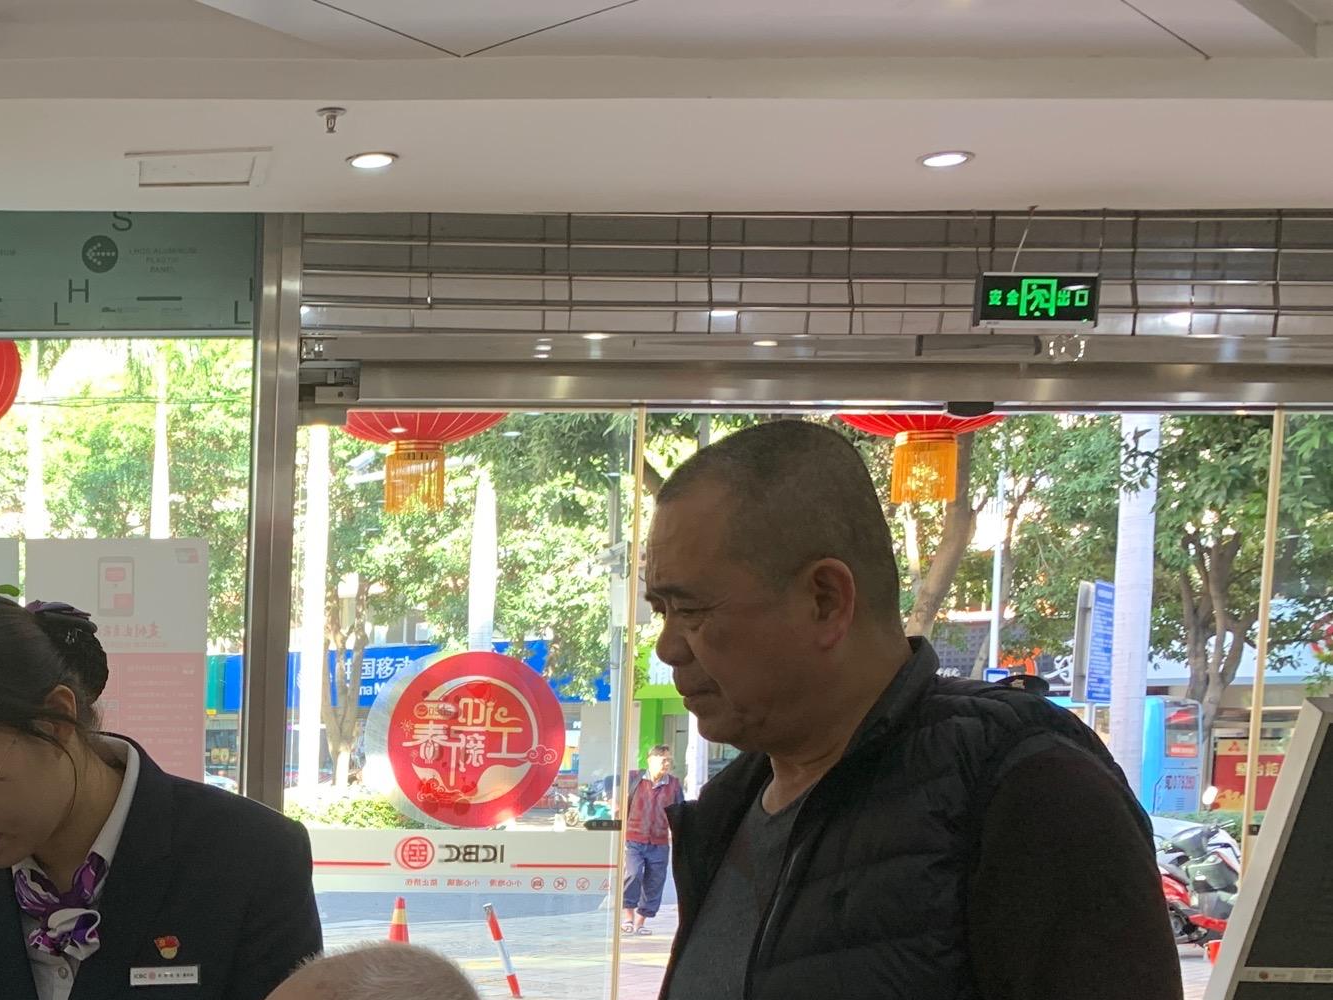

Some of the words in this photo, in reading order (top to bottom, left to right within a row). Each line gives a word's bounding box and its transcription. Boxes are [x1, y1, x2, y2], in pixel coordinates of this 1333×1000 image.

[68, 278, 90, 304] H
[987, 288, 1020, 307] 安全
[1057, 289, 1090, 307] 出口
